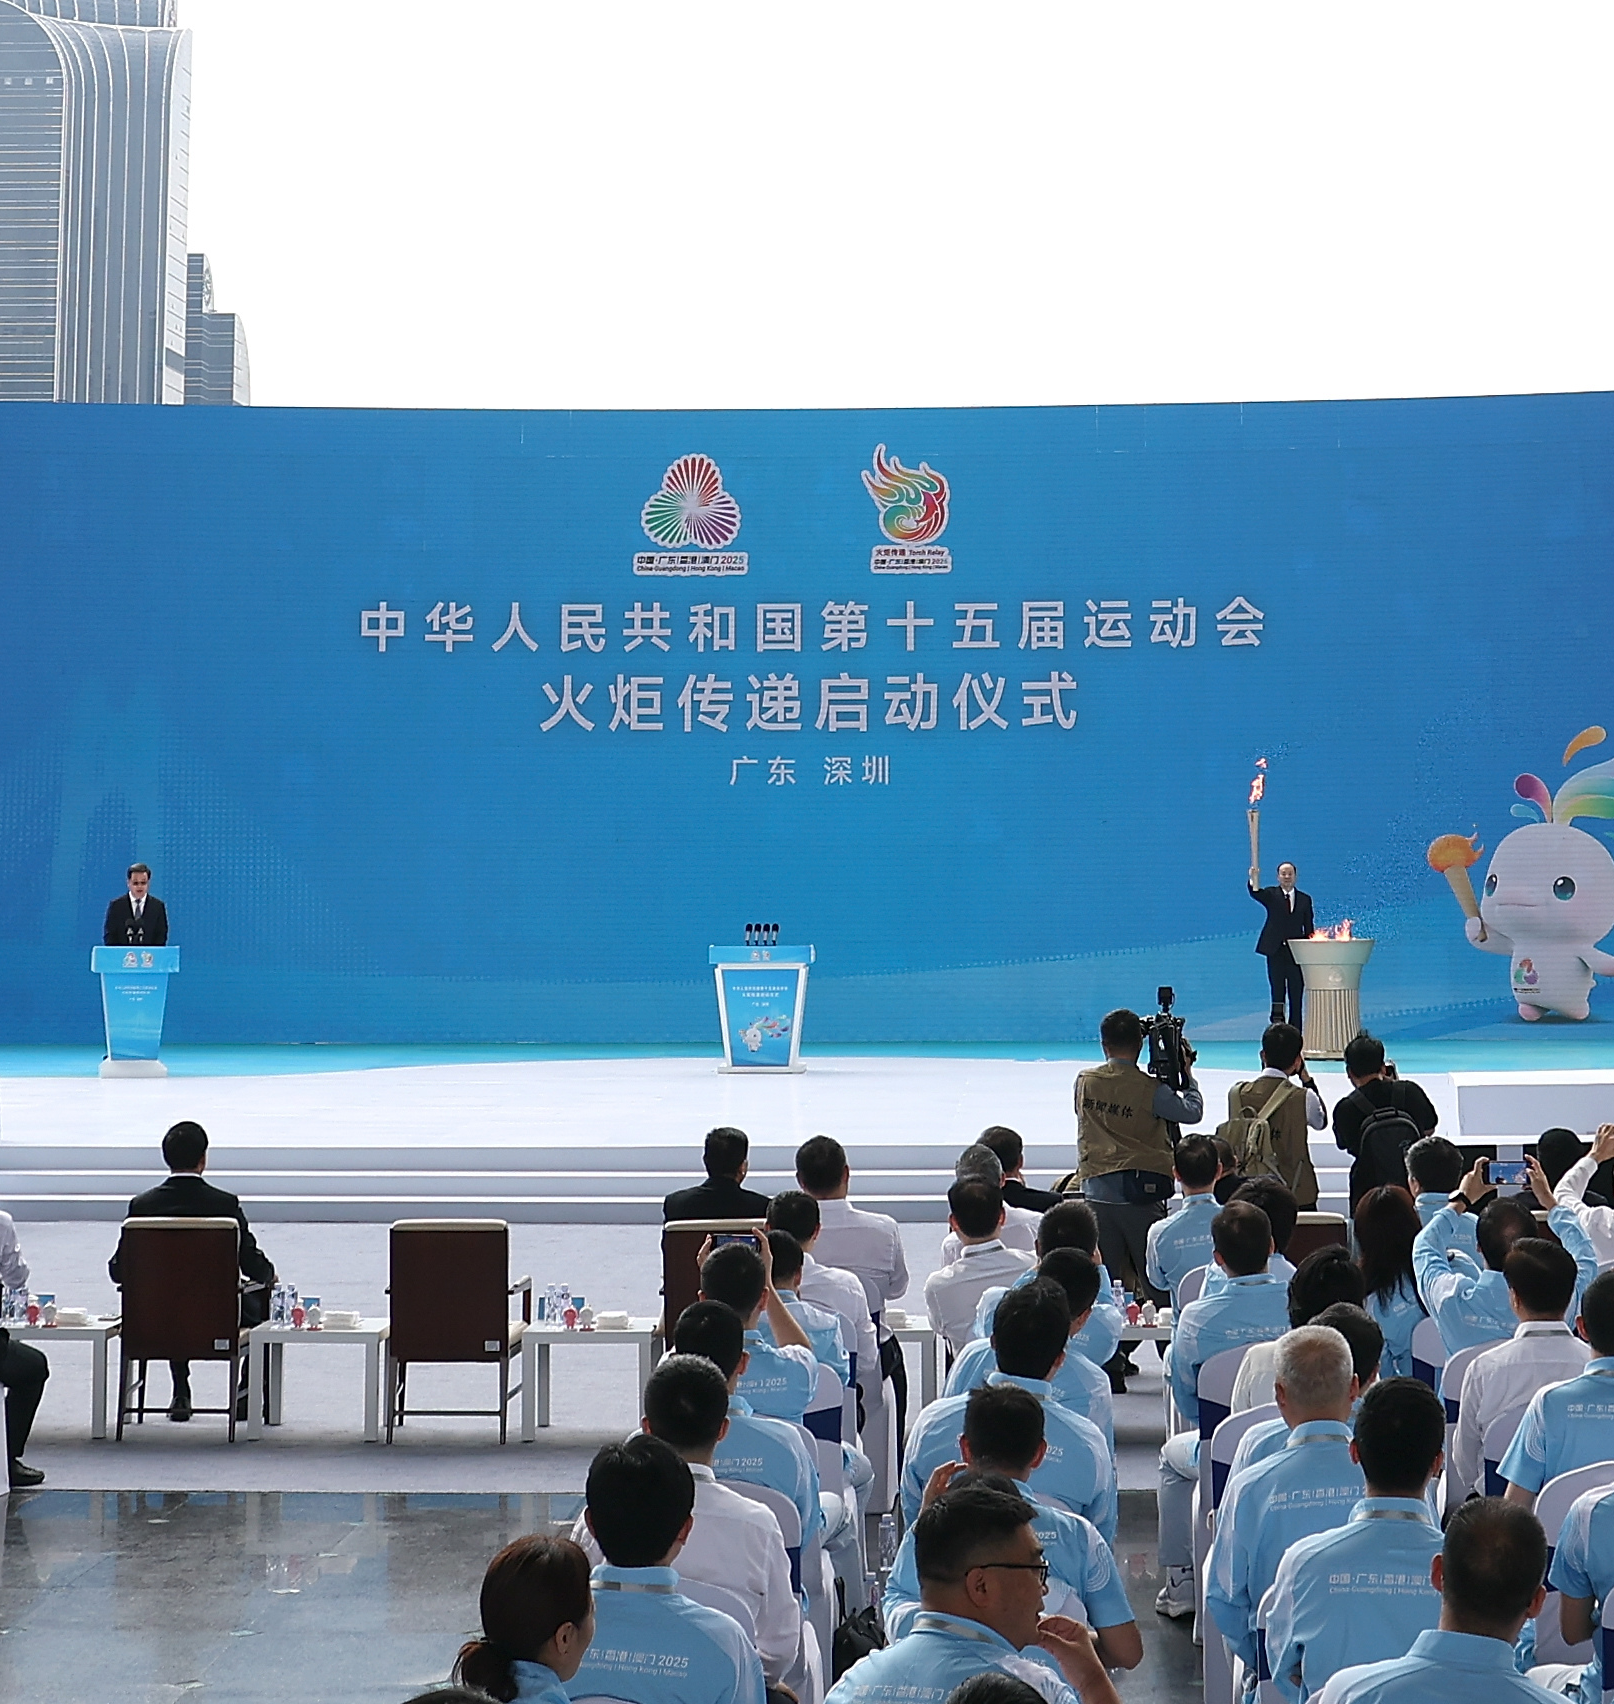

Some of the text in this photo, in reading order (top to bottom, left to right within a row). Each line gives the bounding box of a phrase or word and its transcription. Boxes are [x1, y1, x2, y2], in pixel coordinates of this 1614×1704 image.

[720, 555, 744, 565] 2025
[360, 596, 1265, 653] 中华人民共和国第十五届运动会
[539, 671, 1078, 733] 火炬传递启动仪式
[729, 756, 890, 786] 广东 深圳
[1084, 1098, 1133, 1119] 新闻媒体
[766, 1377, 787, 1387] 2025
[741, 1457, 763, 1467] 2025
[658, 1654, 690, 1669] 2025
